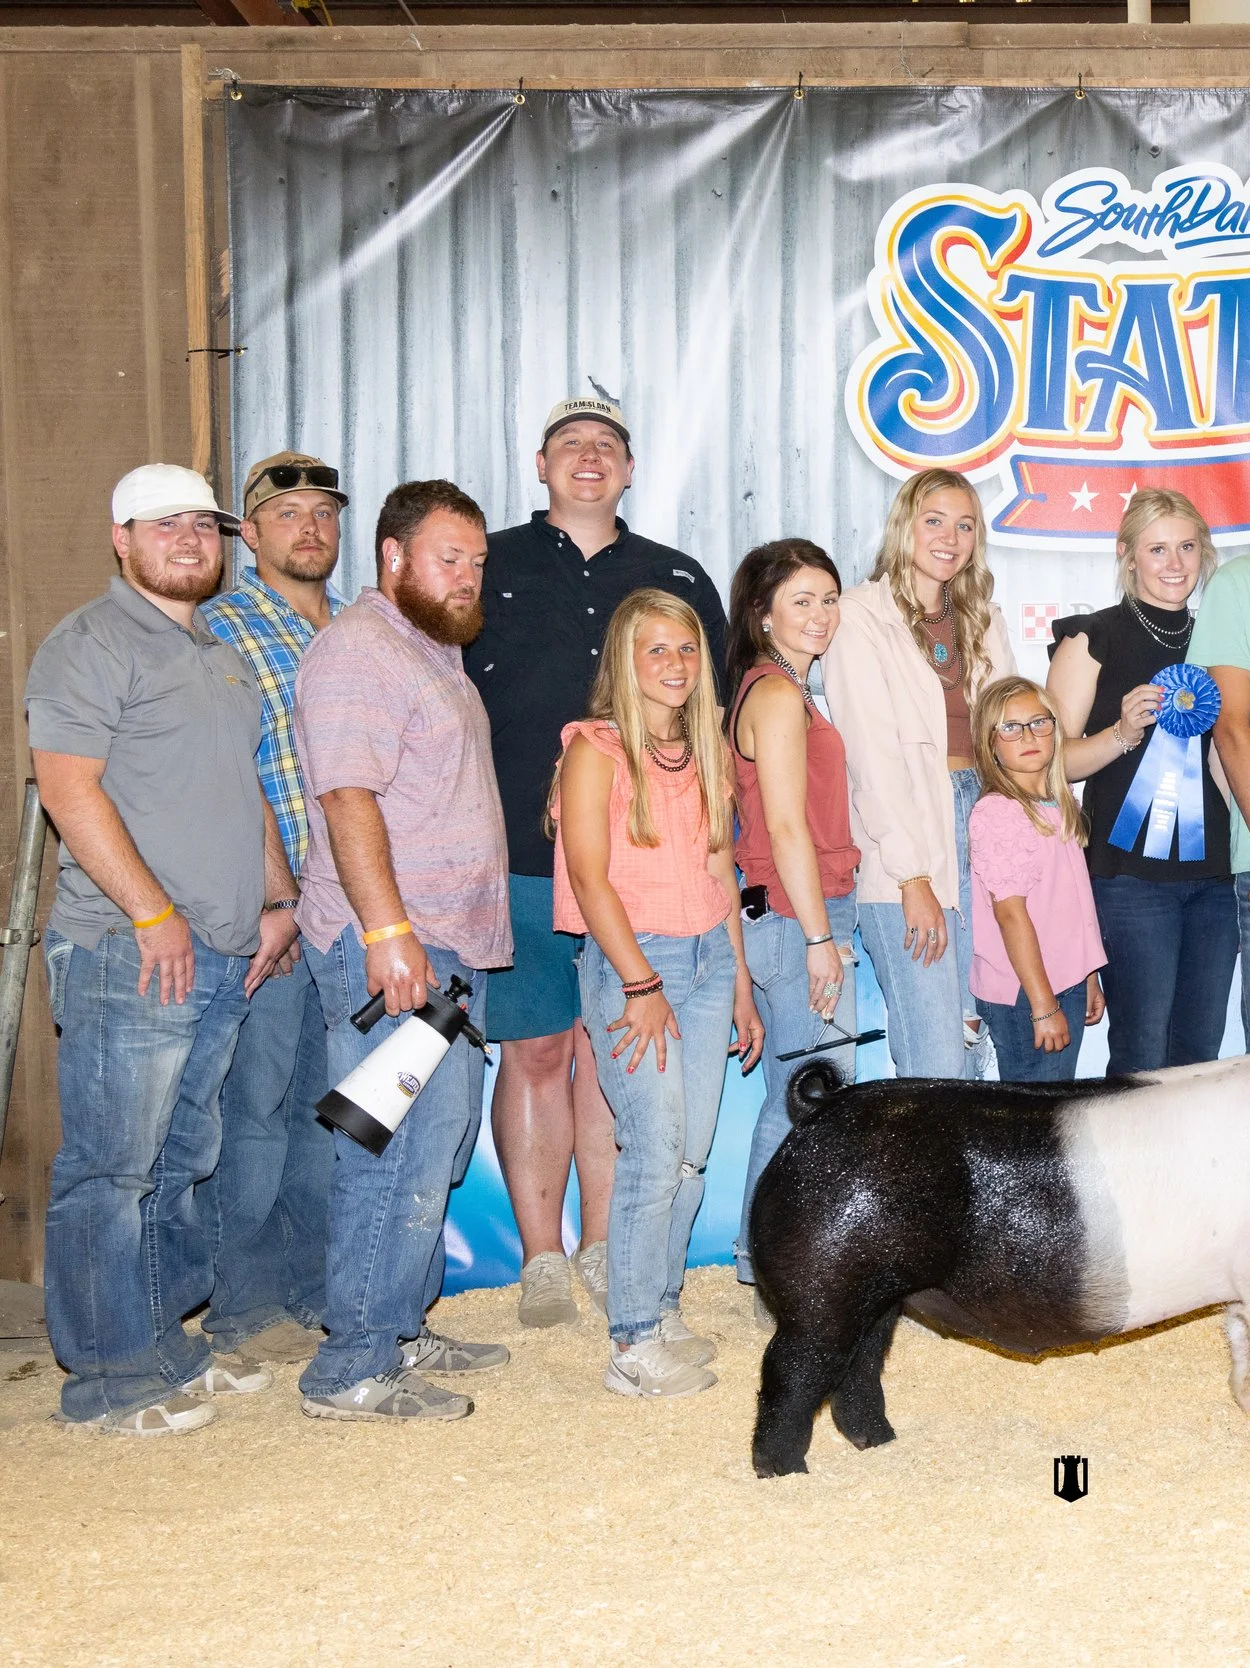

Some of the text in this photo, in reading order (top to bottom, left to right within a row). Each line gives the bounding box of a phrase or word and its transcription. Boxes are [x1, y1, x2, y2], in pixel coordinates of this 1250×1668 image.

[1037, 180, 1193, 258] South
[565, 401, 586, 411] TEAM
[587, 401, 612, 413] SLOAN
